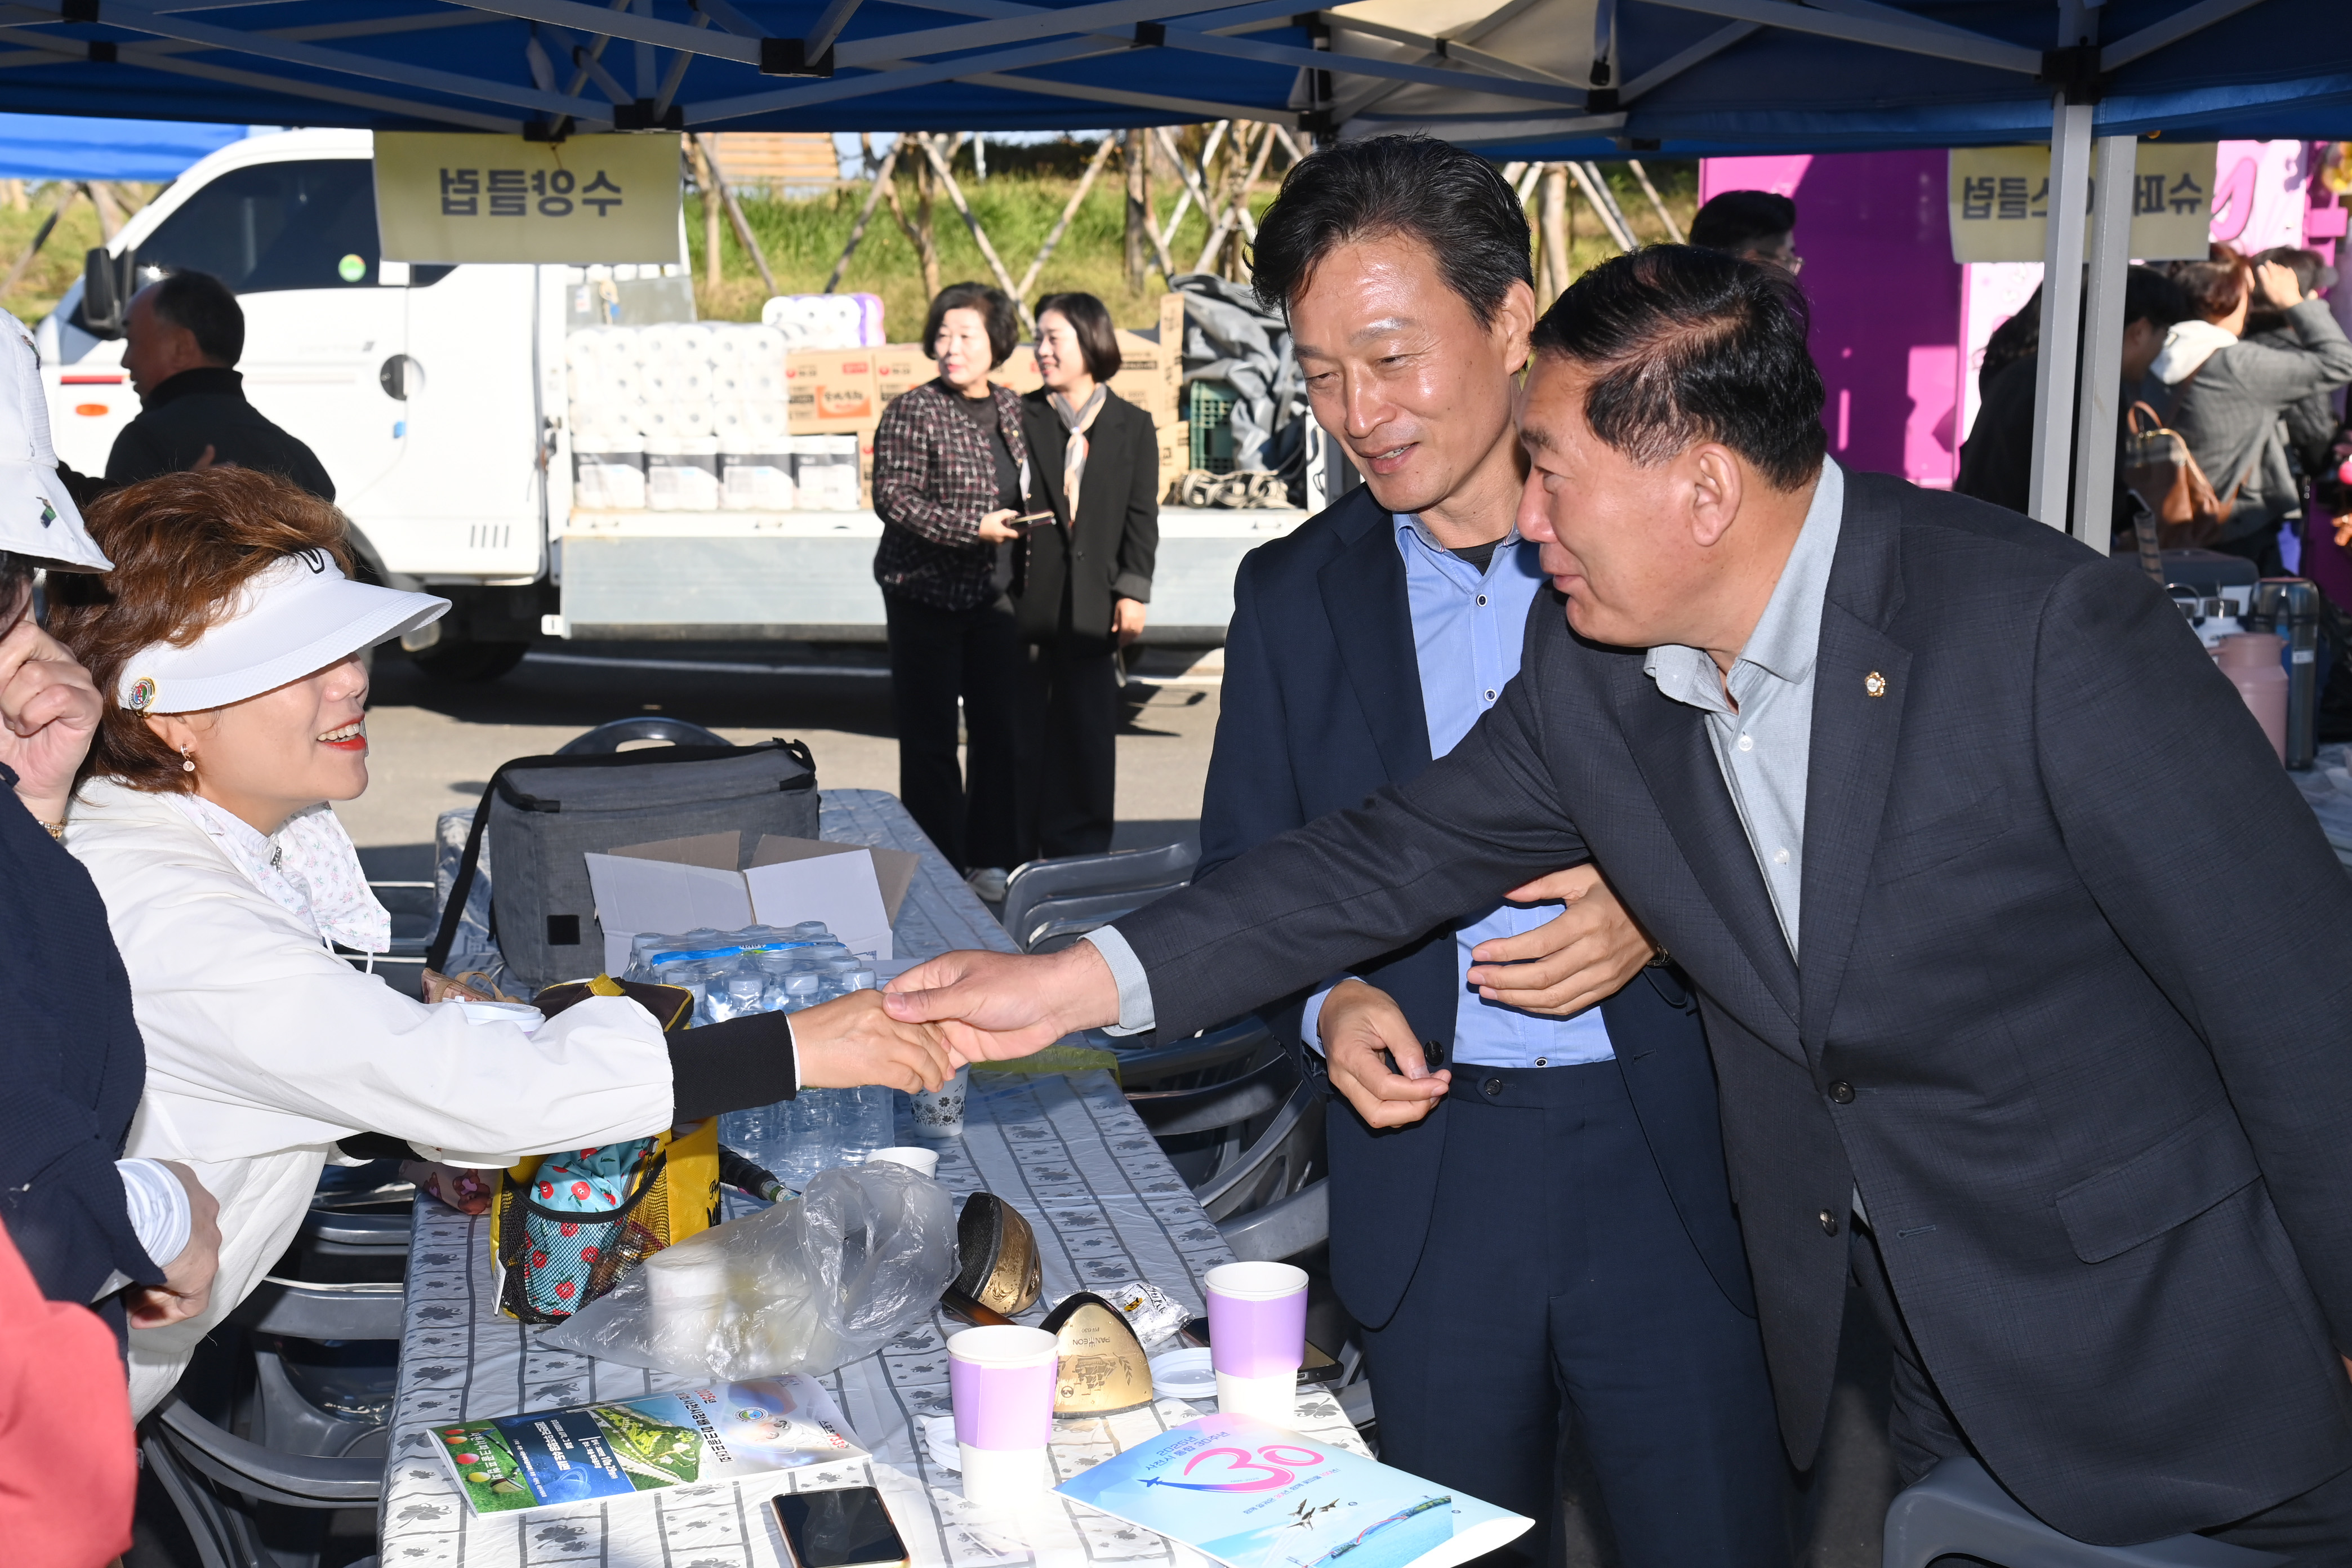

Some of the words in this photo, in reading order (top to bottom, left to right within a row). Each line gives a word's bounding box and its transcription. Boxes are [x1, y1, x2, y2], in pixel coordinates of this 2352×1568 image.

[694, 1389, 717, 1404] 2025년
[683, 1400, 711, 1426] 사천시장배
[701, 1426, 733, 1462] 파크골프대회
[1145, 1455, 1176, 1471] 사천시
[1174, 1445, 1196, 1456] 통합
[1194, 1431, 1231, 1447] 30주년
[1156, 1436, 1199, 1456] 2025년
[469, 1432, 505, 1480] 사천시파크골프협회
